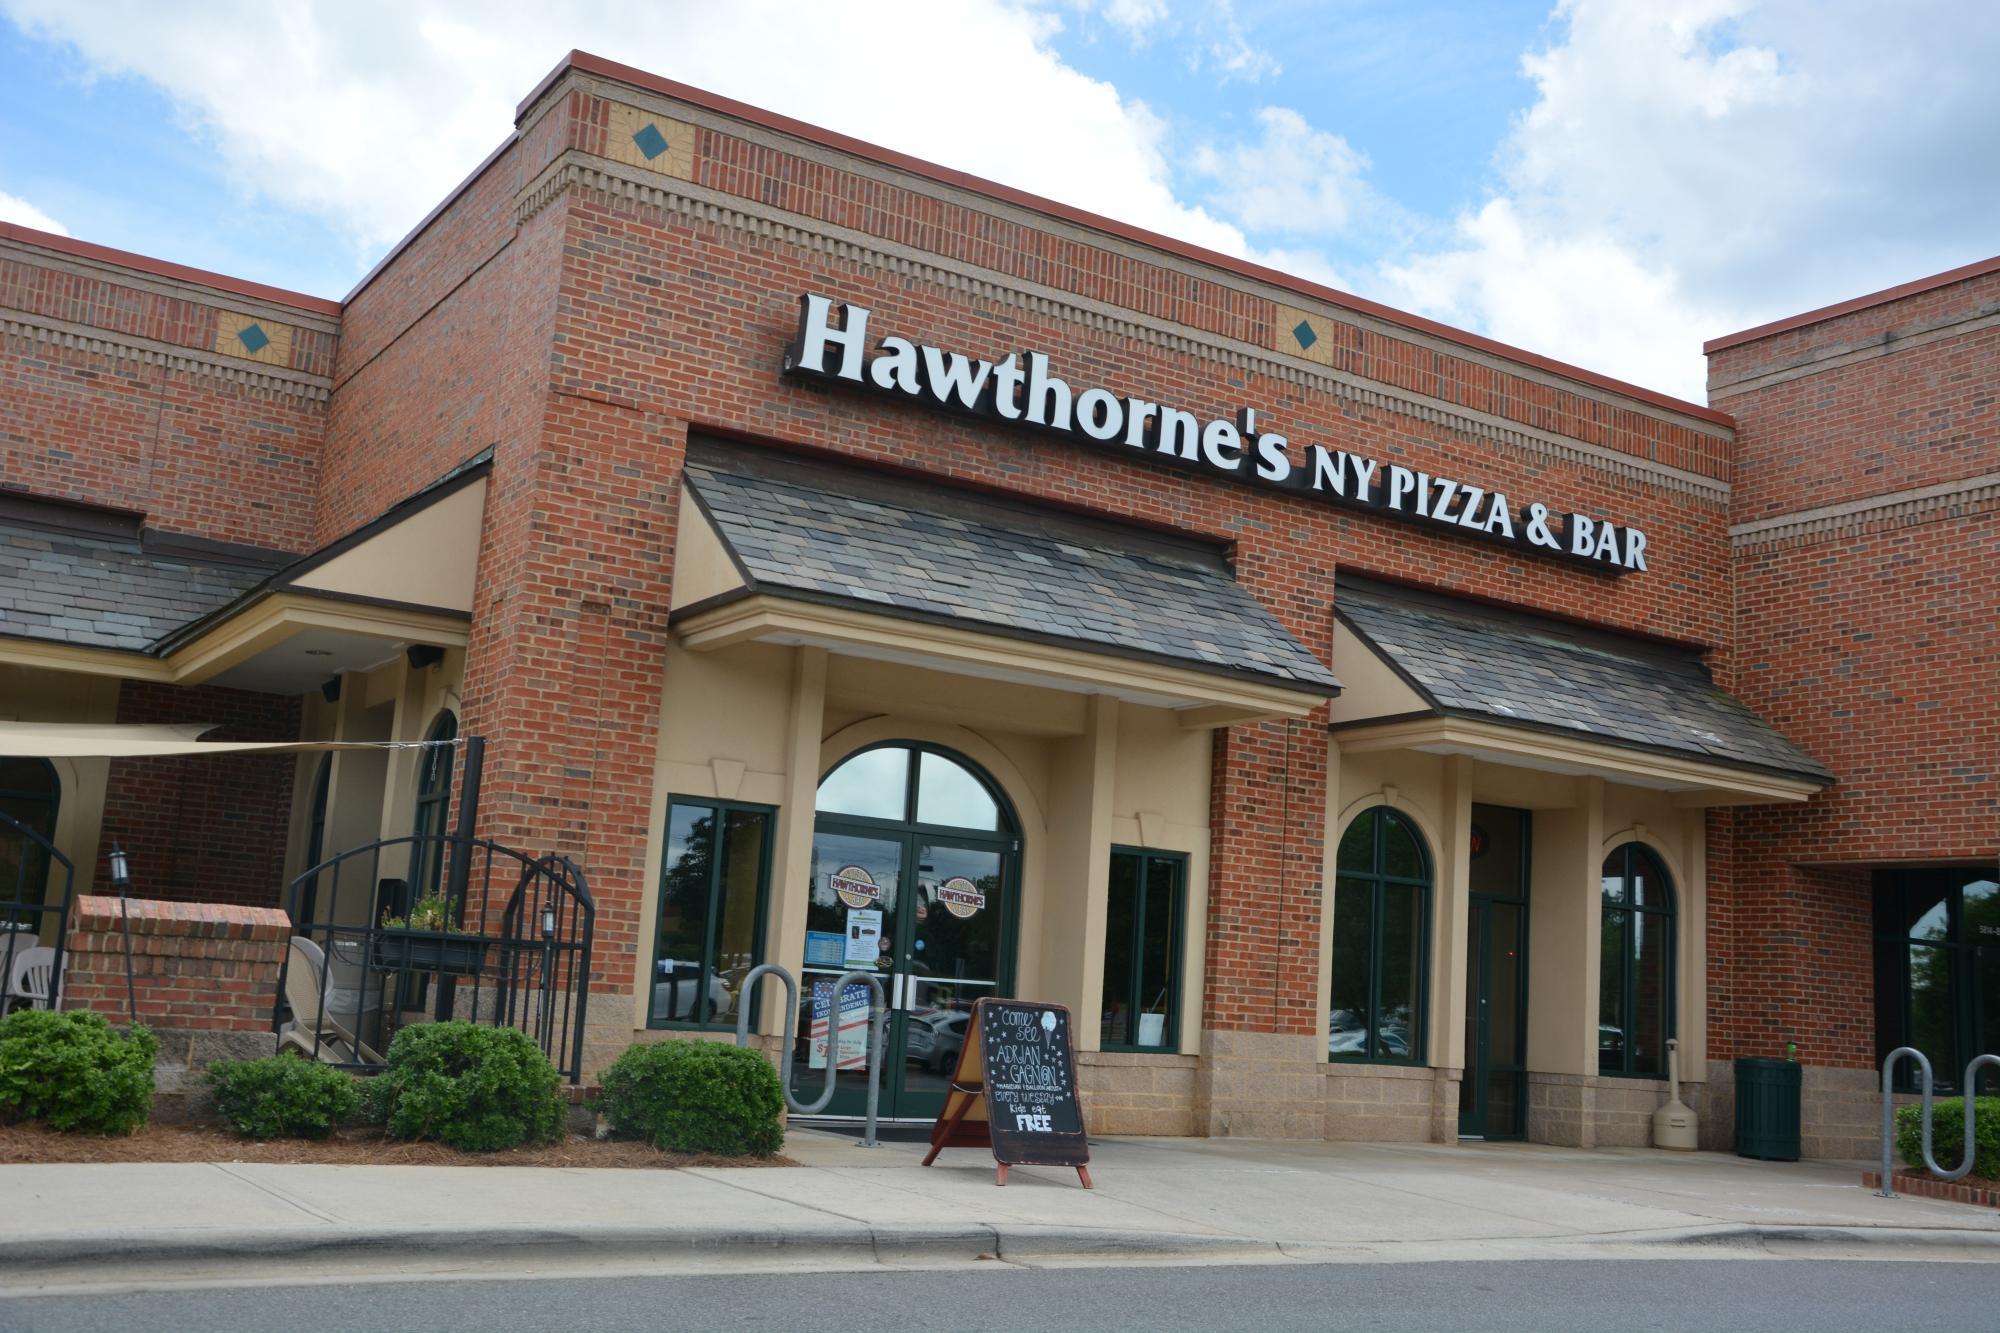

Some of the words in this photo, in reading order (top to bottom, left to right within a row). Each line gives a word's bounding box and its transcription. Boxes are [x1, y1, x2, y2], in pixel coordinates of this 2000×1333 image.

[798, 292, 1291, 482] Hawthorne's
[1311, 445, 1378, 502] NY
[1387, 464, 1516, 539] PIZZA
[1525, 502, 1563, 550] &
[1570, 512, 1649, 572] BAR
[1032, 1104, 1047, 1114] eat
[1016, 1114, 1053, 1132] FREE
